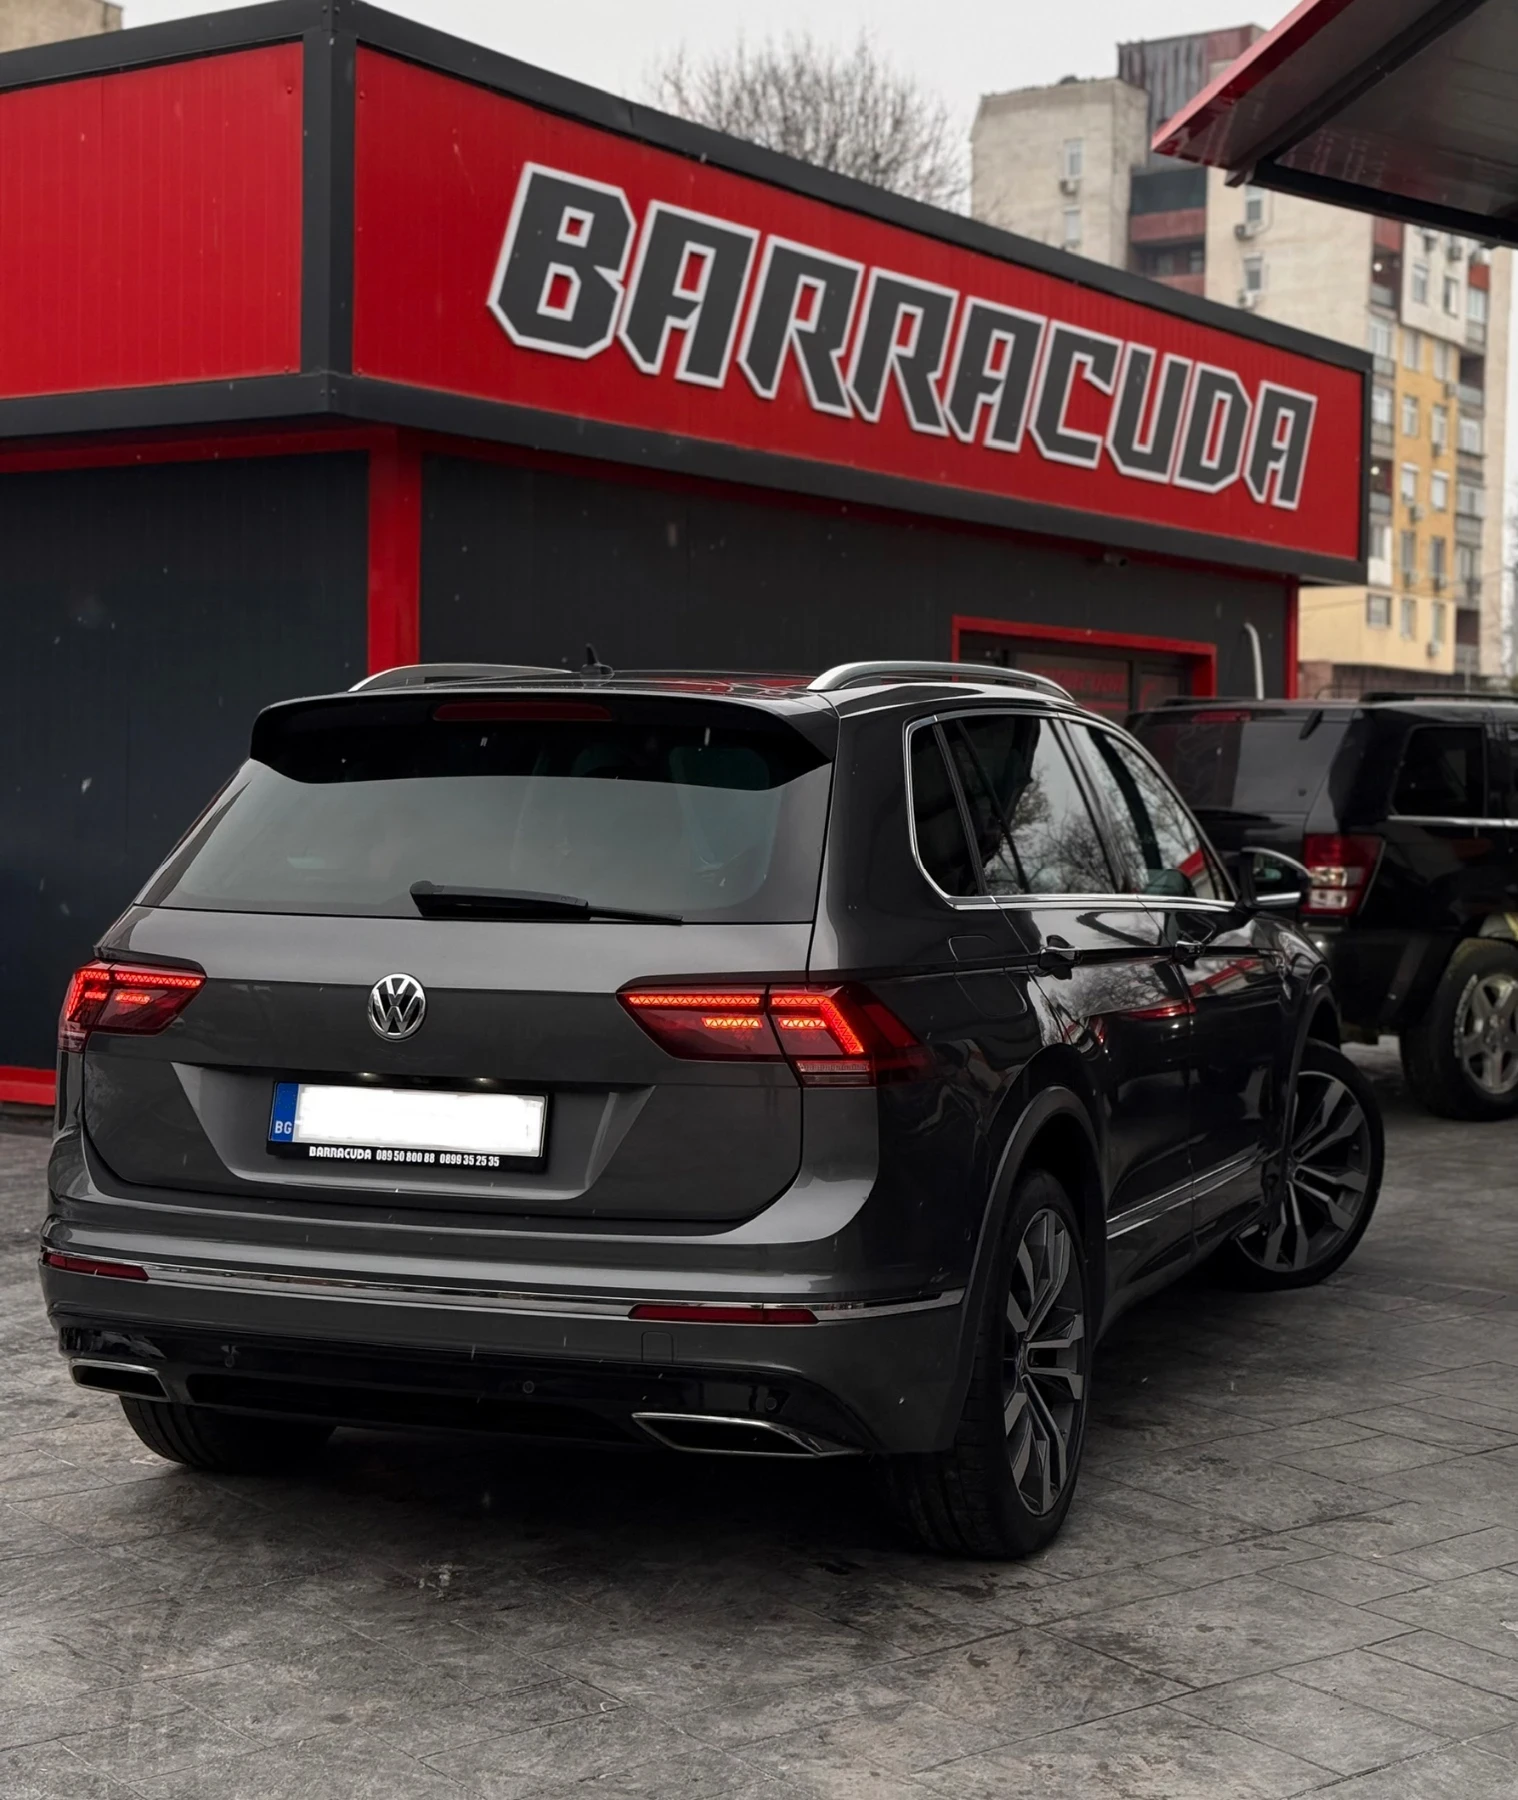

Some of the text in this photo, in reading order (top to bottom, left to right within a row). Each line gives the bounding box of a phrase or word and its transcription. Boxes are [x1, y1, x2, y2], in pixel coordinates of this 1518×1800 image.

[487, 161, 1318, 511] BARRACUDA
[275, 1120, 292, 1134] BG
[309, 1146, 371, 1160] BARRACUDA
